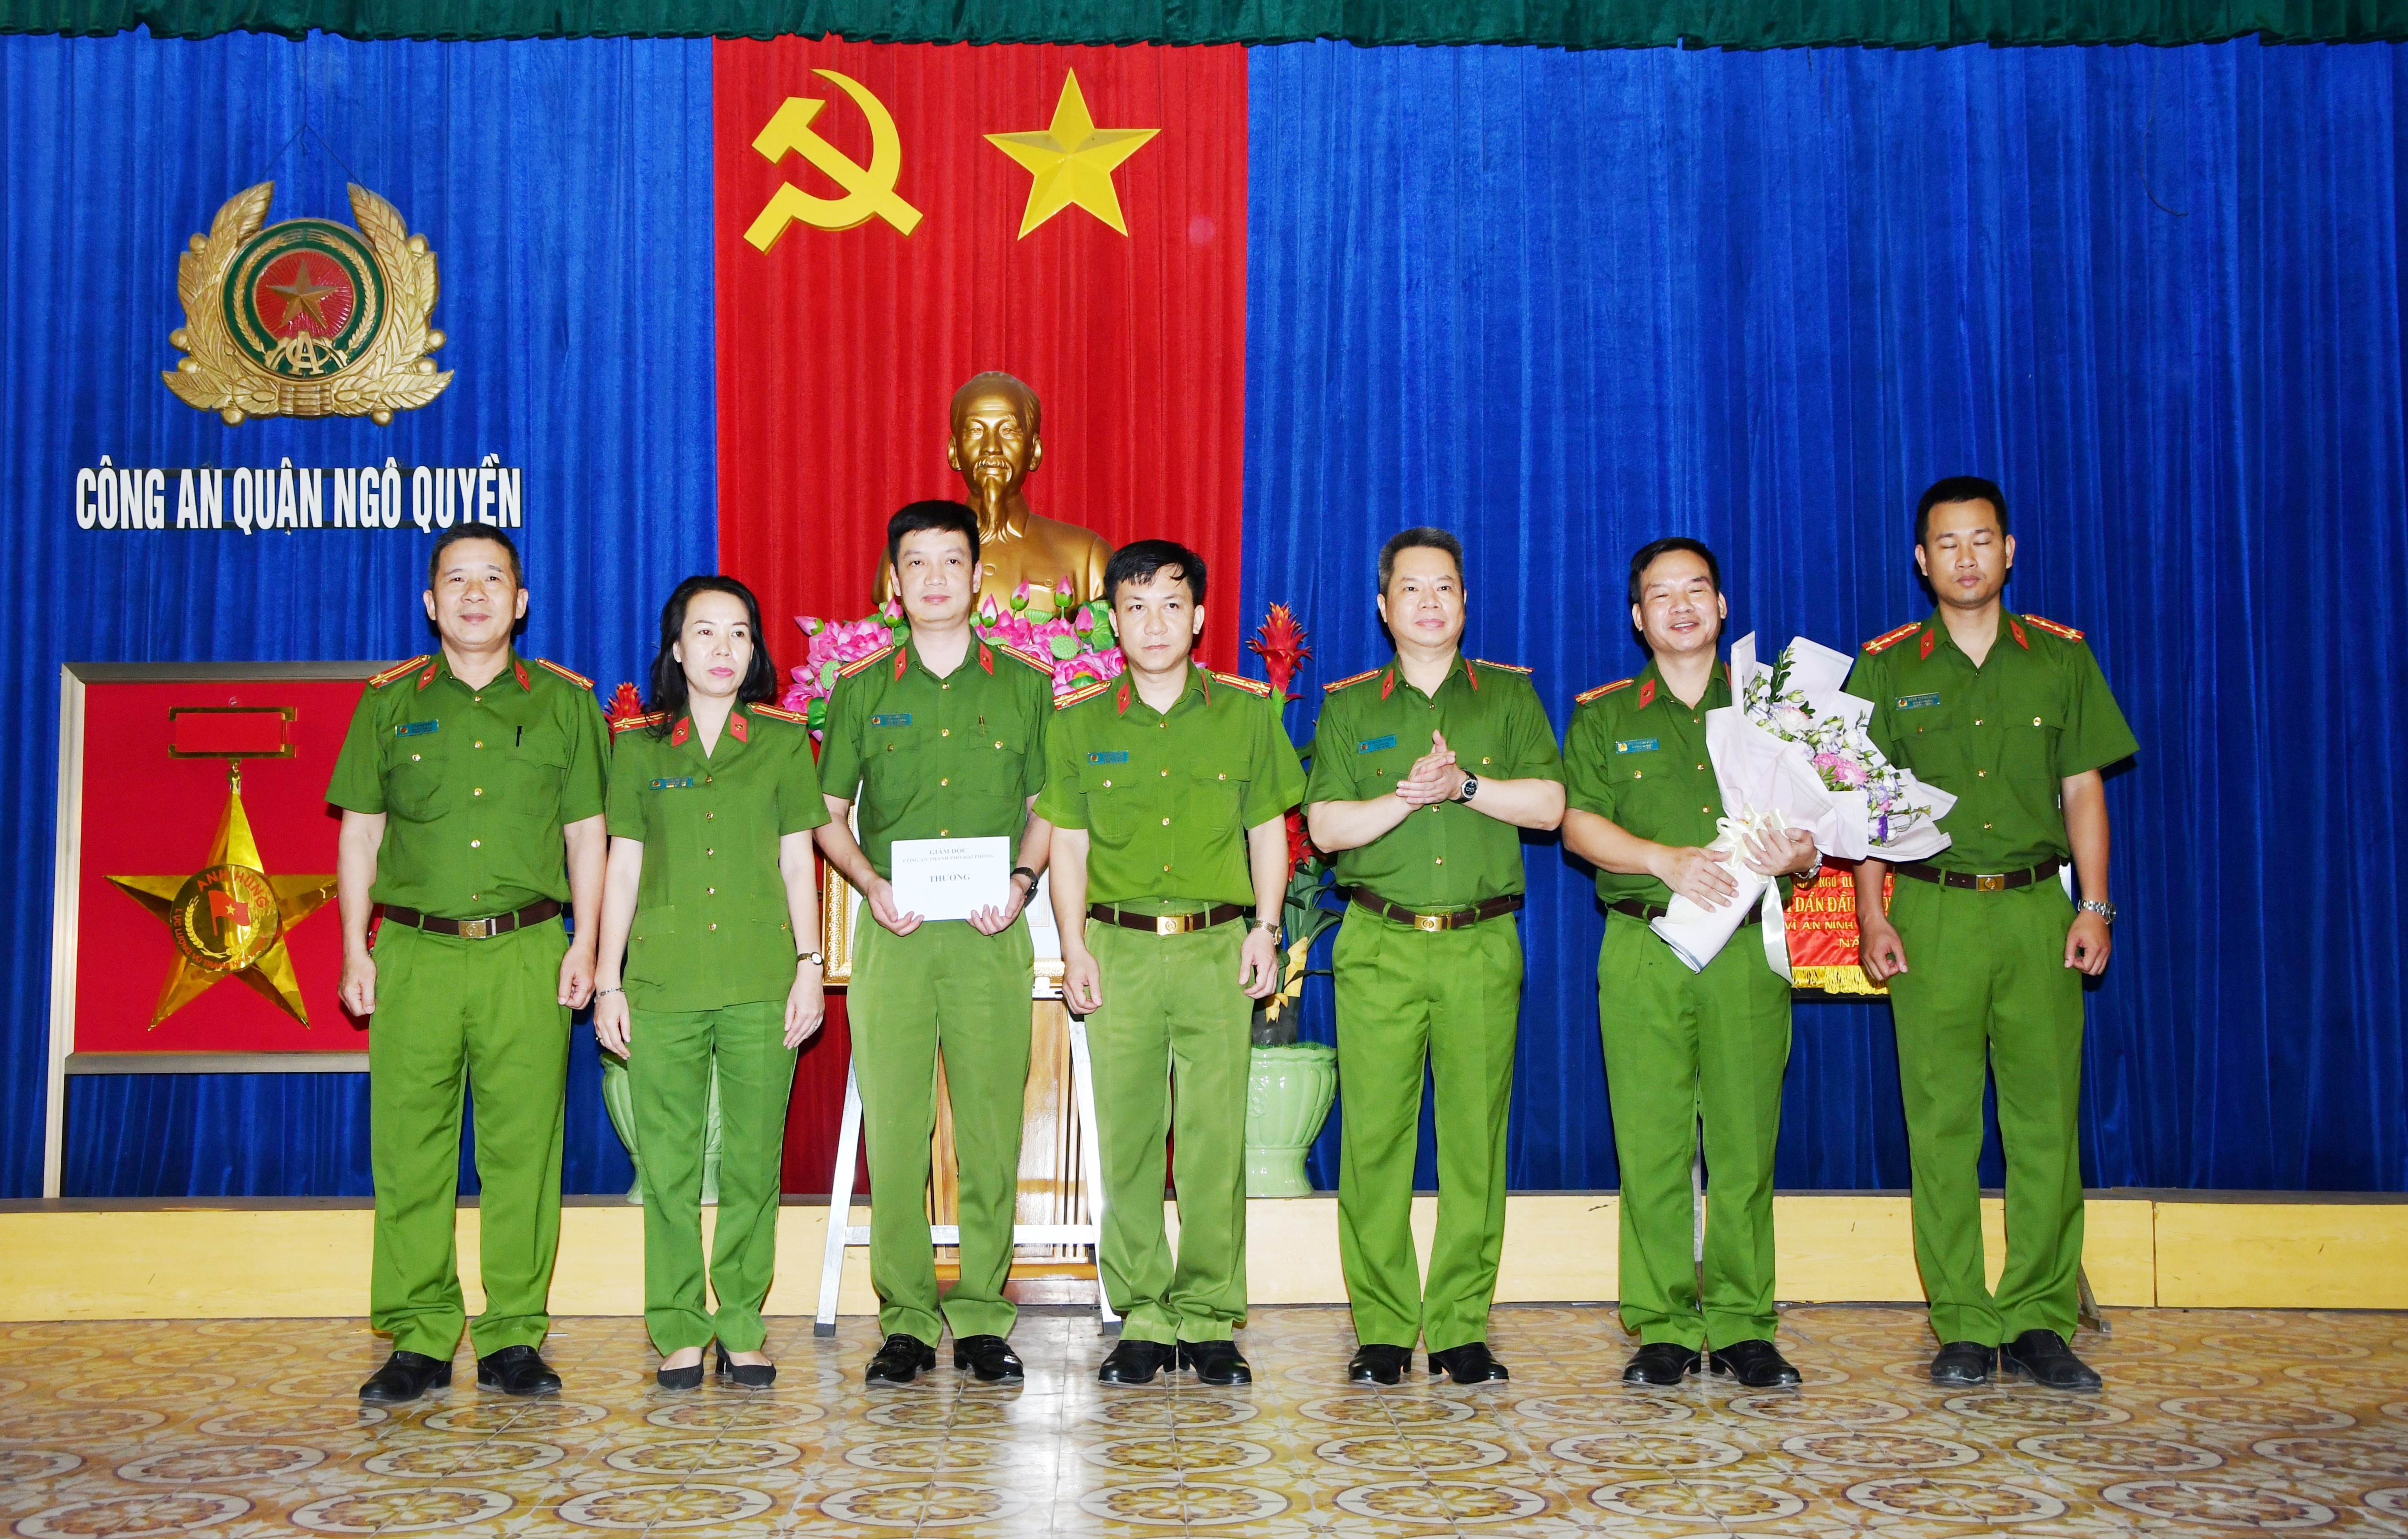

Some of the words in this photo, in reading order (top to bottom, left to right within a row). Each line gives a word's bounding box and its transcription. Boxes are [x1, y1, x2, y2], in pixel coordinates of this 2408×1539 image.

[77, 455, 164, 529] CÔNG
[177, 469, 222, 528] AN
[335, 457, 401, 528] NGÔ
[413, 453, 520, 533] QUYỀN
[197, 868, 229, 892] ANH
[929, 872, 970, 882] THƯỞNG
[1820, 875, 1836, 888] NGÔ
[1828, 891, 1855, 912] ĐẦU
[1825, 921, 1854, 930] NINH
